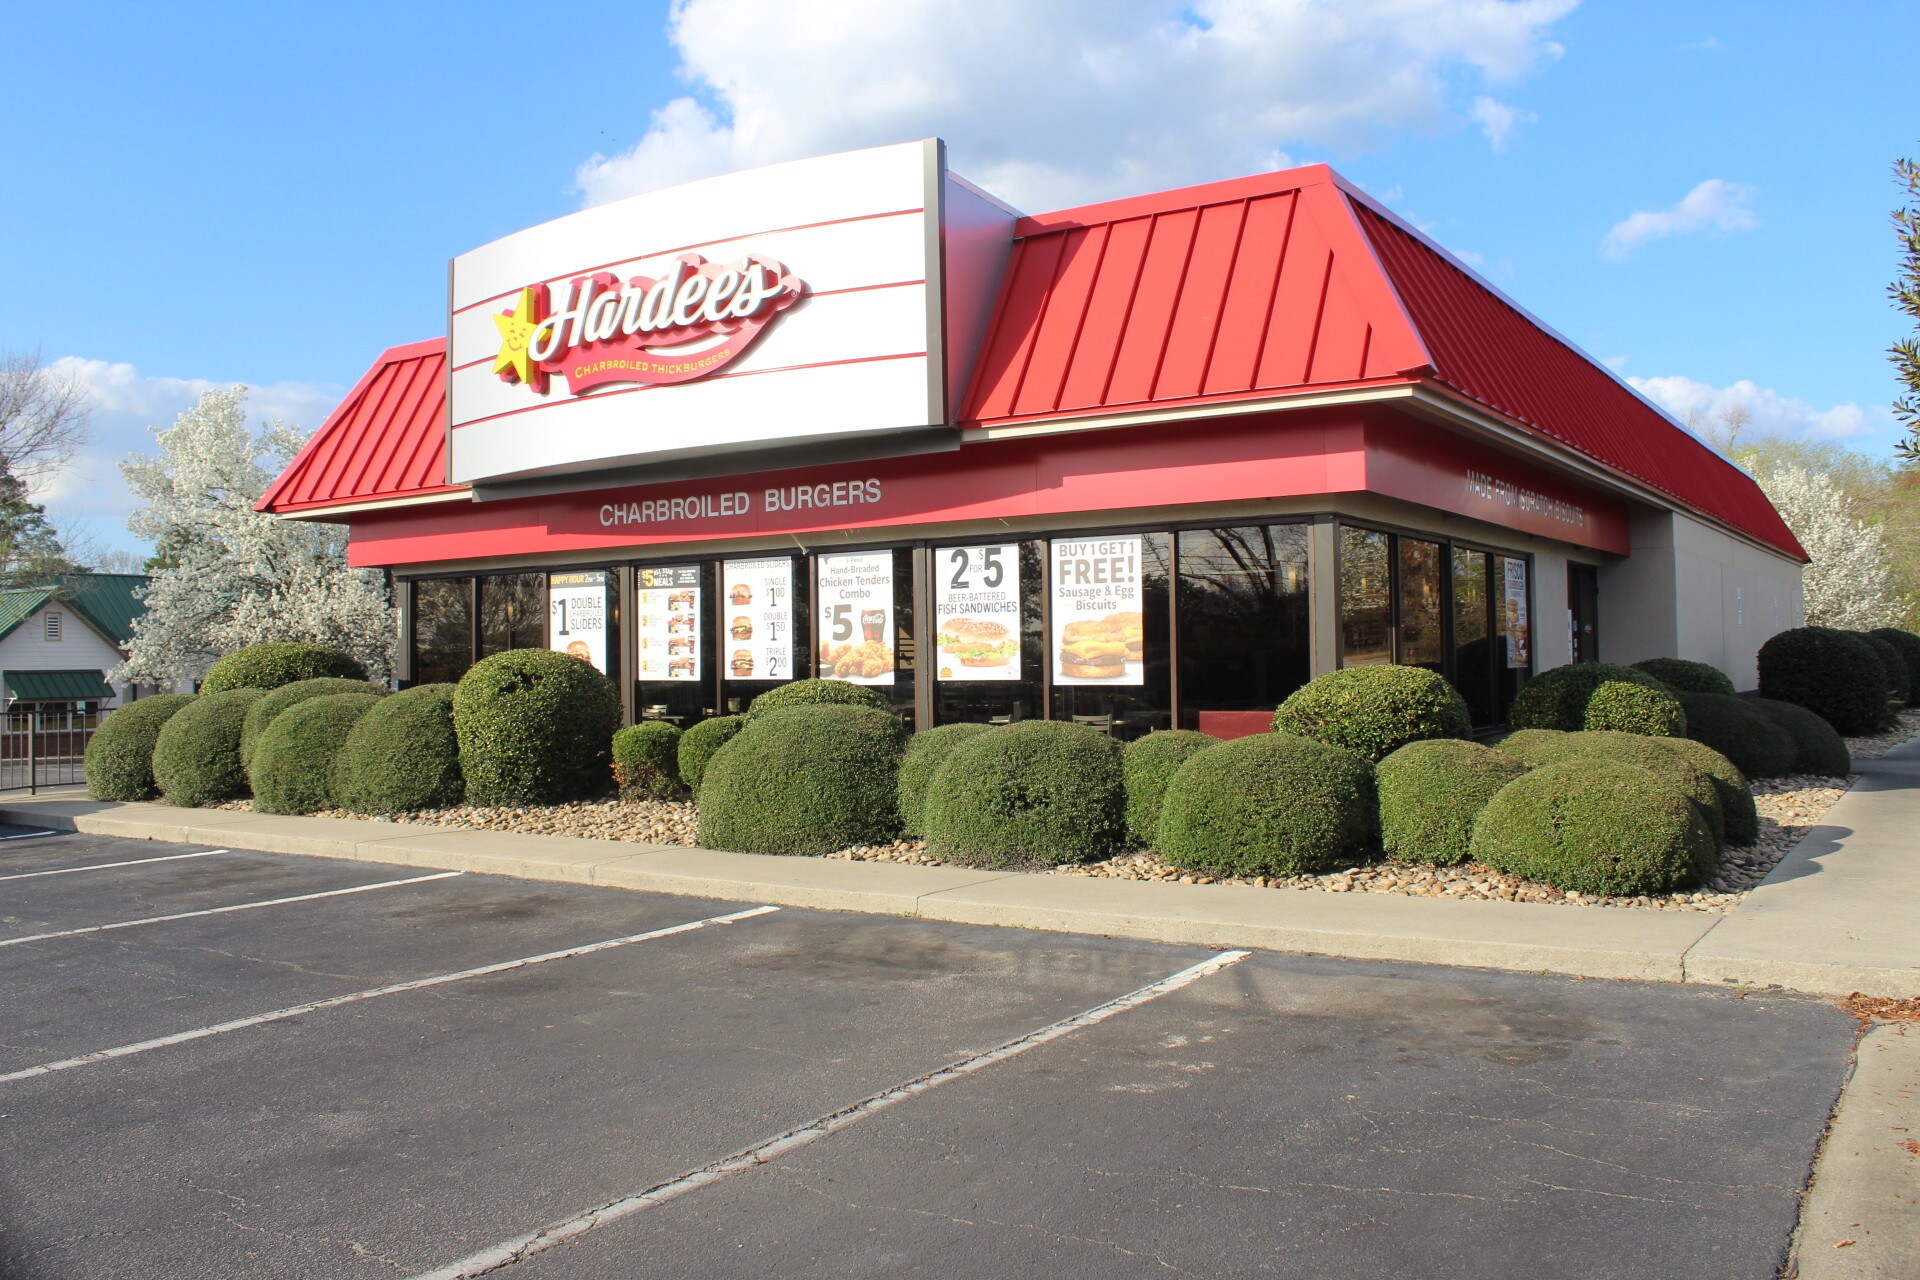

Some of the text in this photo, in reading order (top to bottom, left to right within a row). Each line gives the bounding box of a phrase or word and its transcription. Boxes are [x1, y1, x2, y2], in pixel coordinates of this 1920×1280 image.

[528, 255, 785, 361] Hardee's
[574, 348, 731, 379] CHARBROILED THICKBURGERS
[600, 478, 882, 527] CHARBROILED BURGERS
[1467, 470, 1583, 527] MADE FROM SCRATCH BISCUITS
[1059, 541, 1134, 557] BUY 1 GET 1
[766, 558, 790, 569] SLIDERS
[830, 563, 880, 575] Hand-Breaded
[950, 549, 970, 589] 2
[969, 565, 983, 573] FOR
[1059, 555, 1135, 585] FREE!
[550, 575, 568, 584] HAPPY
[568, 574, 585, 584] HOUR
[653, 577, 674, 587] MEALS
[764, 576, 787, 586] SINGLE
[819, 575, 890, 588] Chicken Tenders
[839, 588, 871, 599] Combo
[948, 592, 1006, 603] BEER-BATTERED
[1059, 585, 1135, 600] Sausage & Egg
[571, 597, 602, 609] DOUBLE
[938, 601, 1018, 615] FISH SANDWICHES
[1076, 600, 1117, 611] Biscuits
[763, 612, 788, 621] DOUBLE
[571, 618, 603, 630] SLIDERS
[765, 648, 787, 656] TRIPLE
